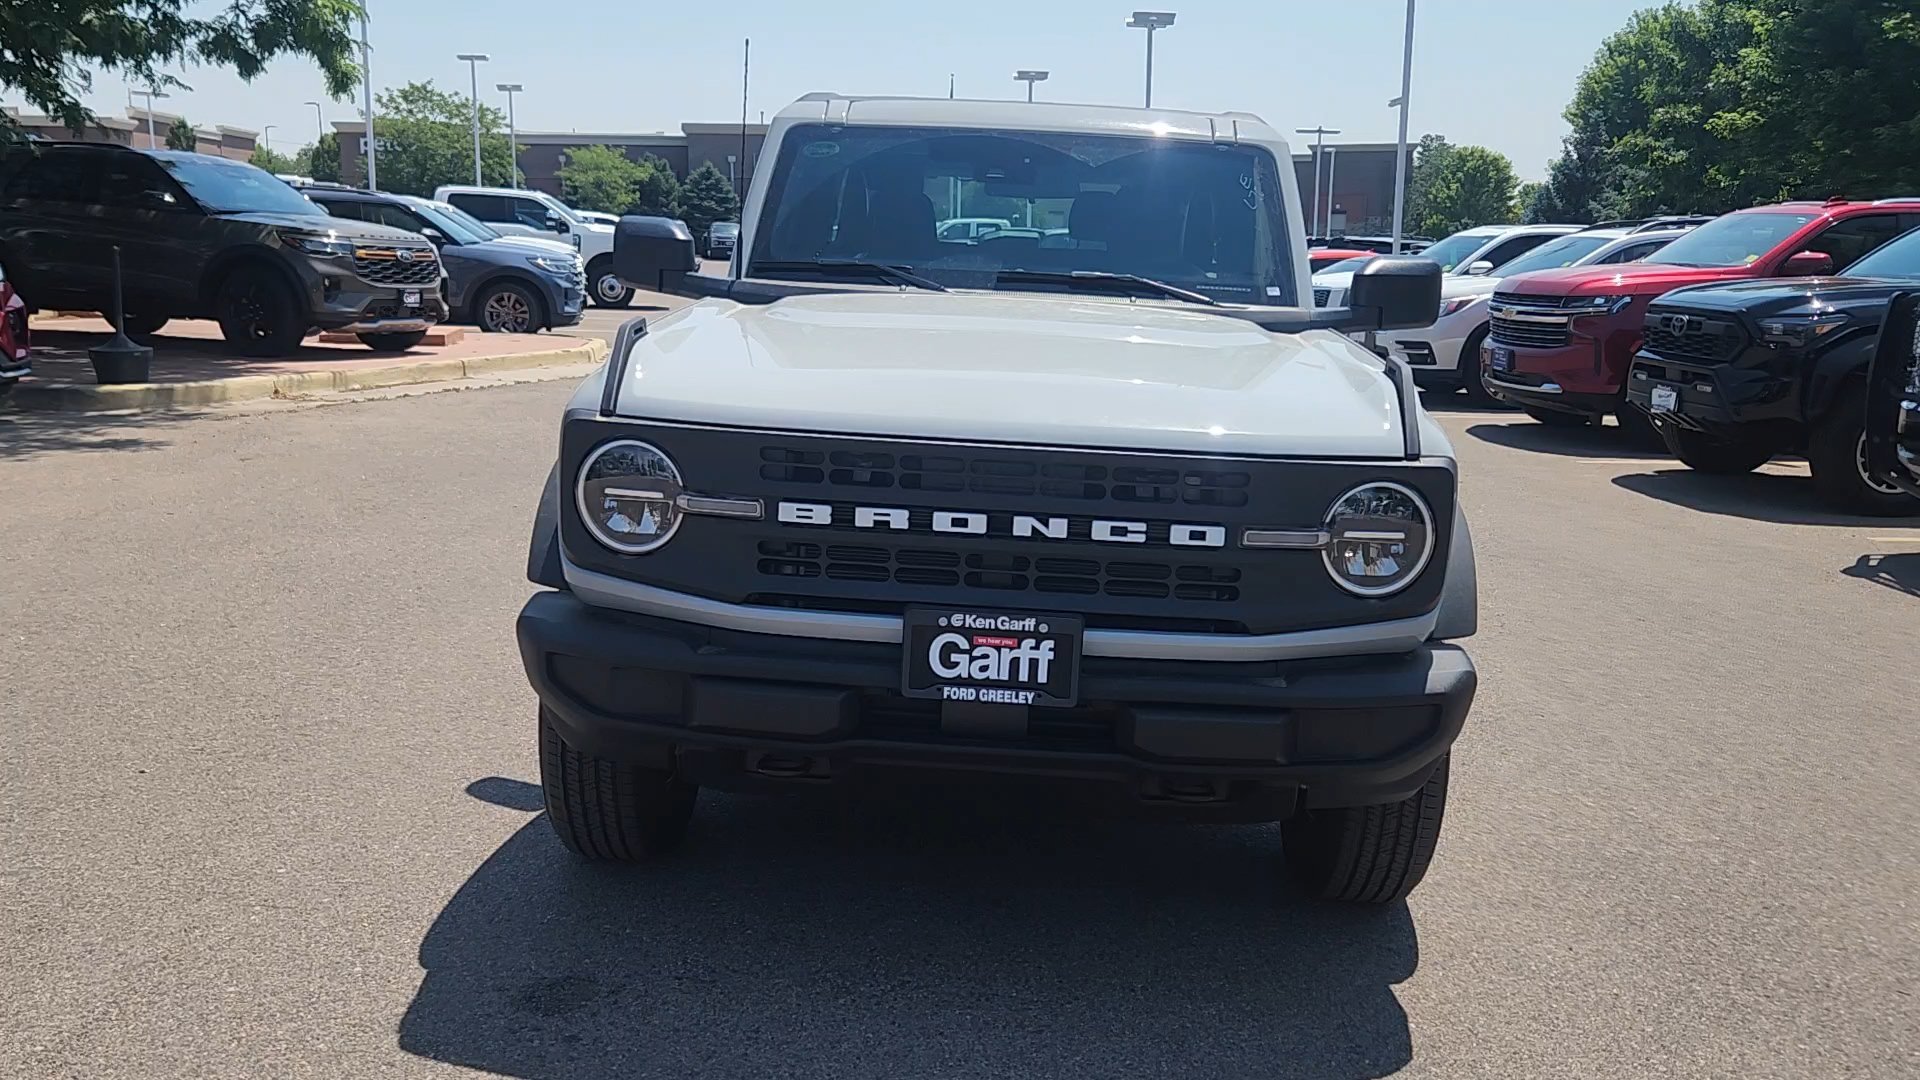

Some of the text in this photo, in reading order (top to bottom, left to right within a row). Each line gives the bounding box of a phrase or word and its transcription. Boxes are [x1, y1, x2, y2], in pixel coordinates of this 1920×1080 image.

[777, 501, 1226, 547] BRONCO
[996, 615, 1037, 632] Garff
[977, 637, 987, 645] we
[987, 637, 1001, 645] hear
[928, 632, 1055, 684] Garff
[943, 686, 1036, 704] FORD GREELEY
